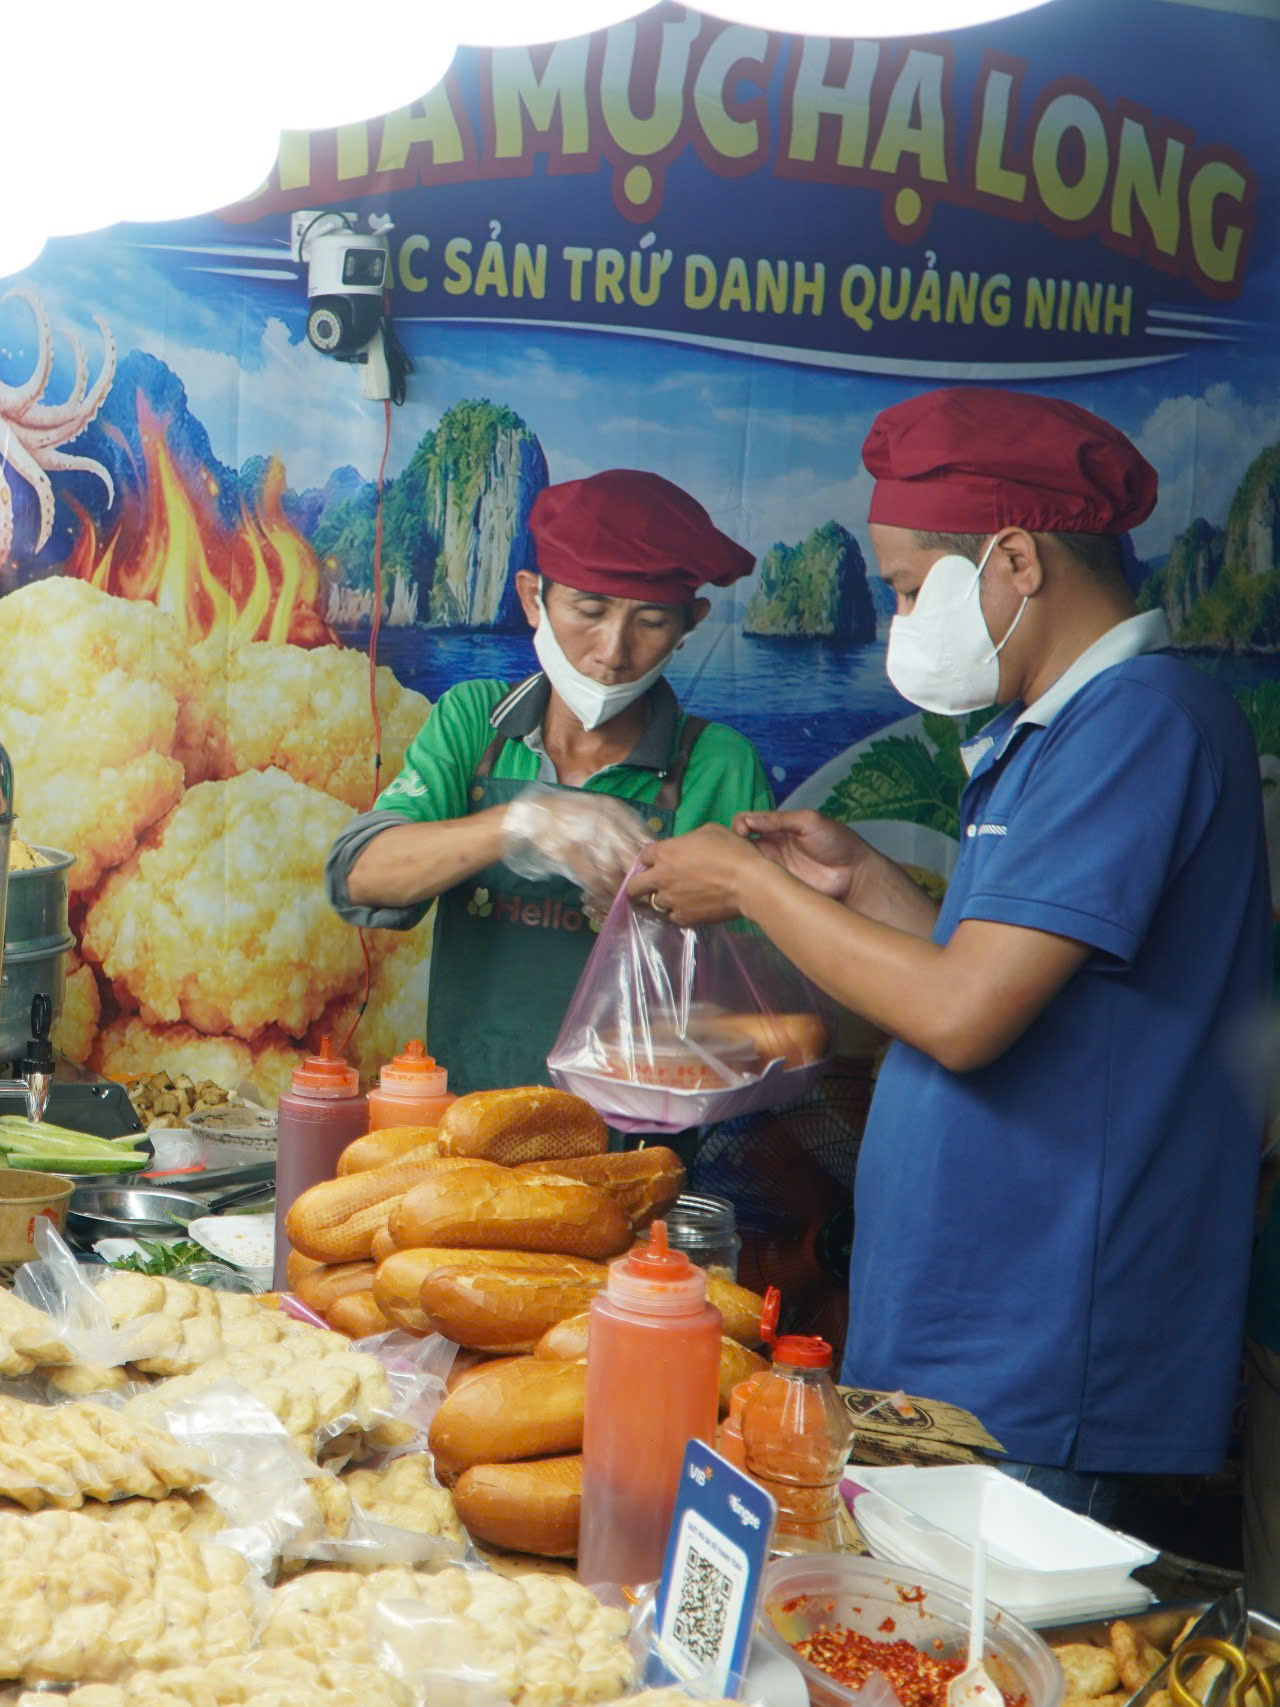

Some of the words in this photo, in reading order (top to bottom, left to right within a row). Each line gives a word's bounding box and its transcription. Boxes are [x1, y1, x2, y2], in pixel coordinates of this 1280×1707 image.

[491, 8, 768, 205] MỰC
[788, 37, 948, 226] HẠ
[975, 69, 1246, 283] LONG
[442, 219, 548, 300] SẢN
[562, 231, 673, 307] TRỨ
[684, 254, 825, 316] DANH
[840, 250, 1012, 331] QUẢNG
[1023, 277, 1133, 336] NINH
[496, 894, 583, 932] Hello
[689, 1463, 706, 1487] VIB
